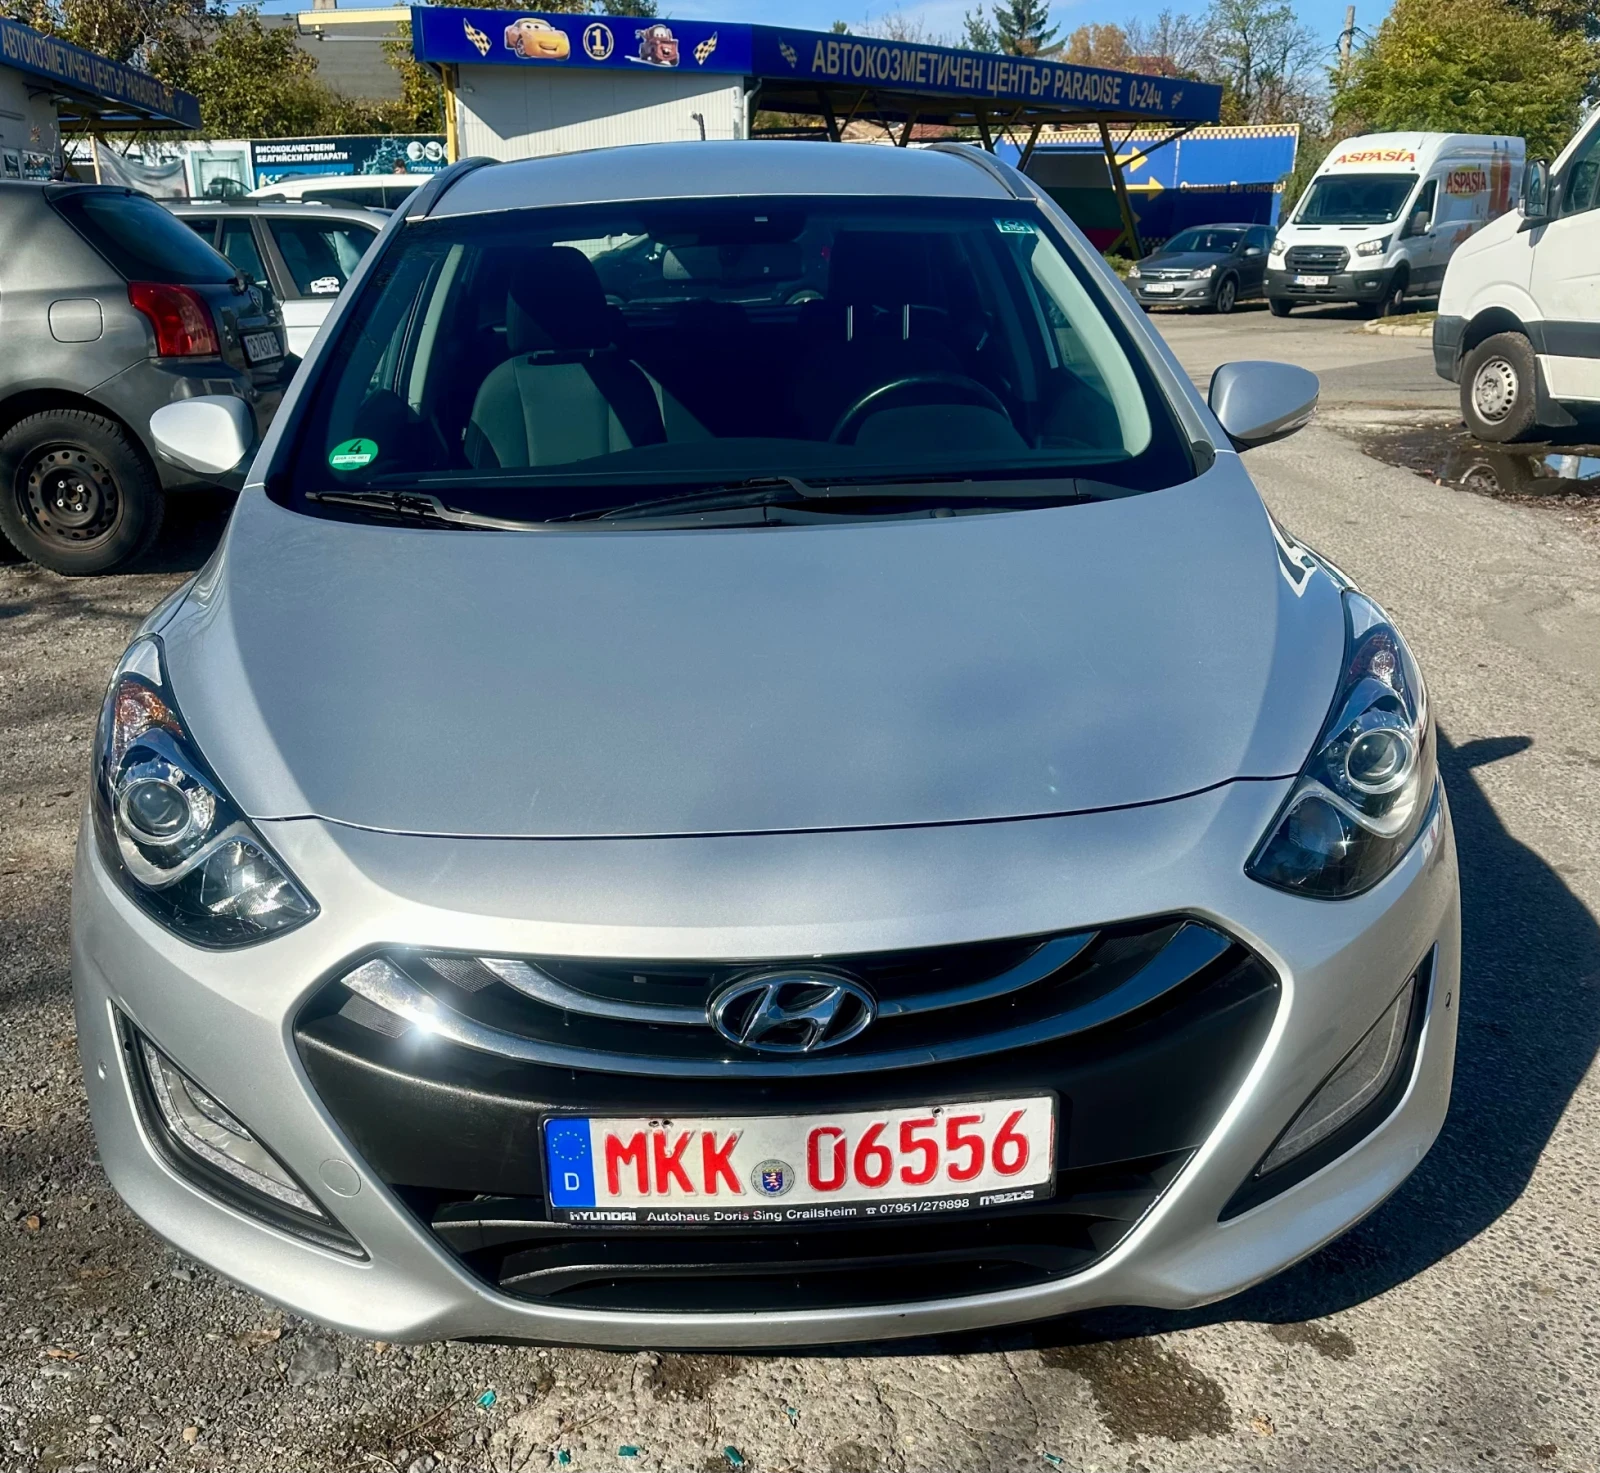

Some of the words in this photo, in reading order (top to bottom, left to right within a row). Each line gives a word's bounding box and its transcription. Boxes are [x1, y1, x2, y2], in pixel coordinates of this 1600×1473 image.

[592, 29, 604, 50] 1
[2, 24, 91, 82] АВТОКОЗМЕТИЧЕН
[92, 58, 124, 95] ЦЕНТЪР
[812, 40, 983, 89] АВТОКОЗМЕТИЧЕН
[986, 61, 1051, 97] ЦЕНТЪР
[1054, 70, 1122, 105] PARADISE
[255, 143, 336, 154] ВИСОКОКАЧЕСТВЕНИ
[256, 154, 303, 163] БЕЛГИЙСКИ
[303, 153, 348, 162] ПРЕПАРАТИ
[348, 439, 362, 454] 4
[564, 1172, 580, 1191] D
[605, 1129, 745, 1196] MKK
[806, 1109, 1030, 1192] 06556
[570, 1211, 637, 1221] HYUNDAI
[646, 1210, 711, 1222] Autohaus
[714, 1210, 749, 1222] Doris
[752, 1209, 783, 1223] Sing
[786, 1206, 857, 1220] Crailsheim
[880, 1199, 970, 1214] 07951/279898
